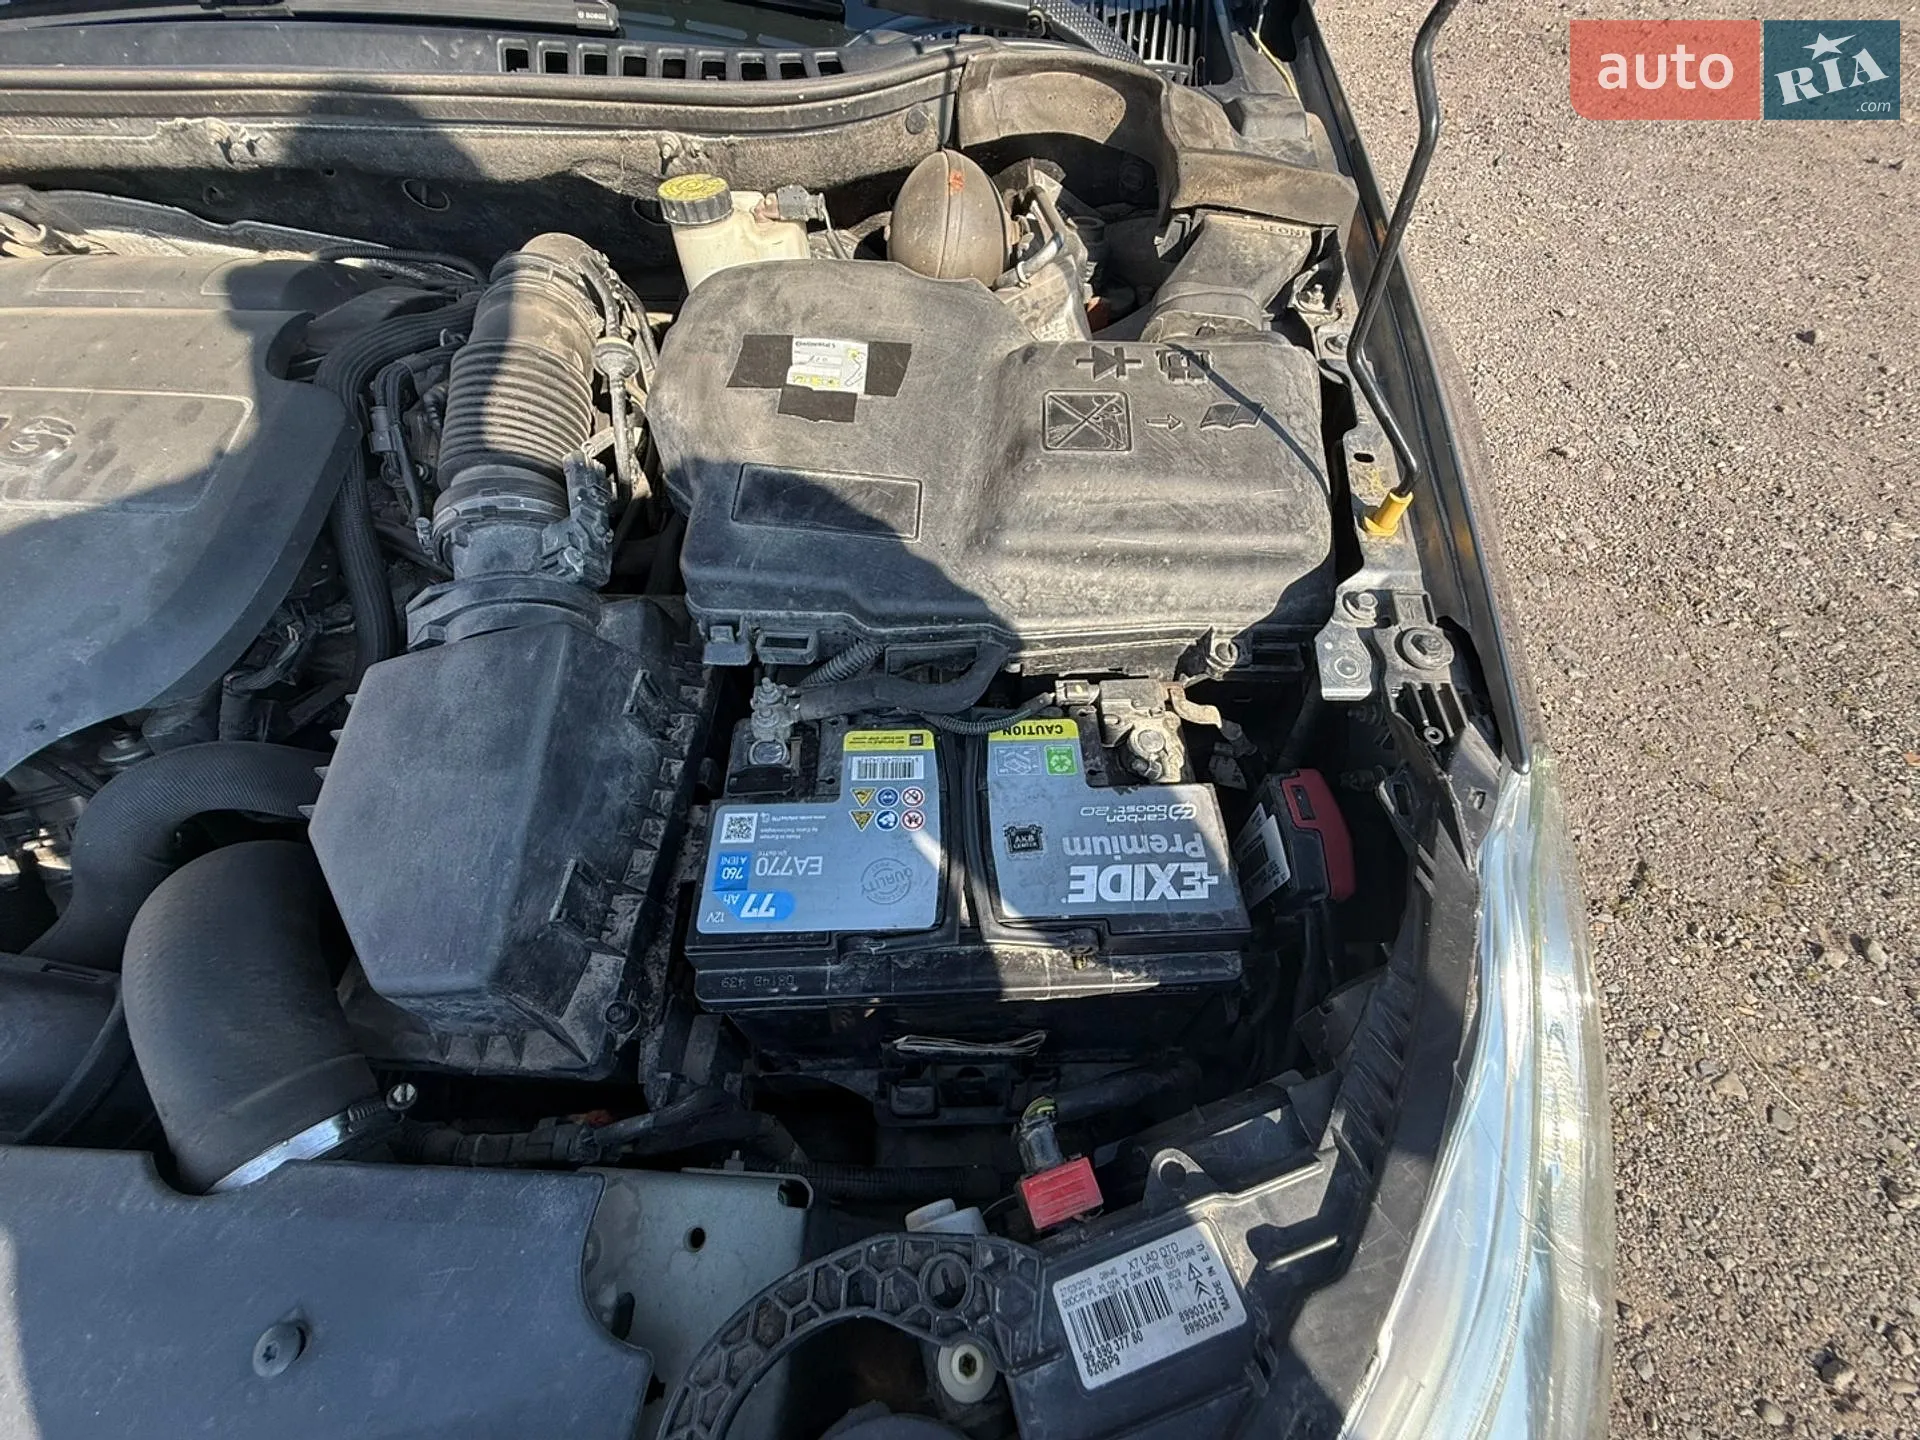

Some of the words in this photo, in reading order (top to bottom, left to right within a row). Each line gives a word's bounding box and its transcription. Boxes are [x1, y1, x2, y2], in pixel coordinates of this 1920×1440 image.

[1002, 723, 1064, 736] CAUTION
[1117, 804, 1168, 814] boost
[1106, 814, 1168, 823] carbon
[1062, 832, 1204, 860] Premium
[721, 865, 744, 880] 760
[755, 855, 823, 877] EA770
[862, 866, 914, 894] QUALITY
[1066, 862, 1219, 903] EXIDE
[723, 893, 740, 905] Ah
[740, 892, 776, 918] 77
[706, 910, 725, 924] 12V
[1140, 1250, 1159, 1266] LAD
[1211, 1279, 1232, 1311] MADE
[1113, 1333, 1129, 1352] 377
